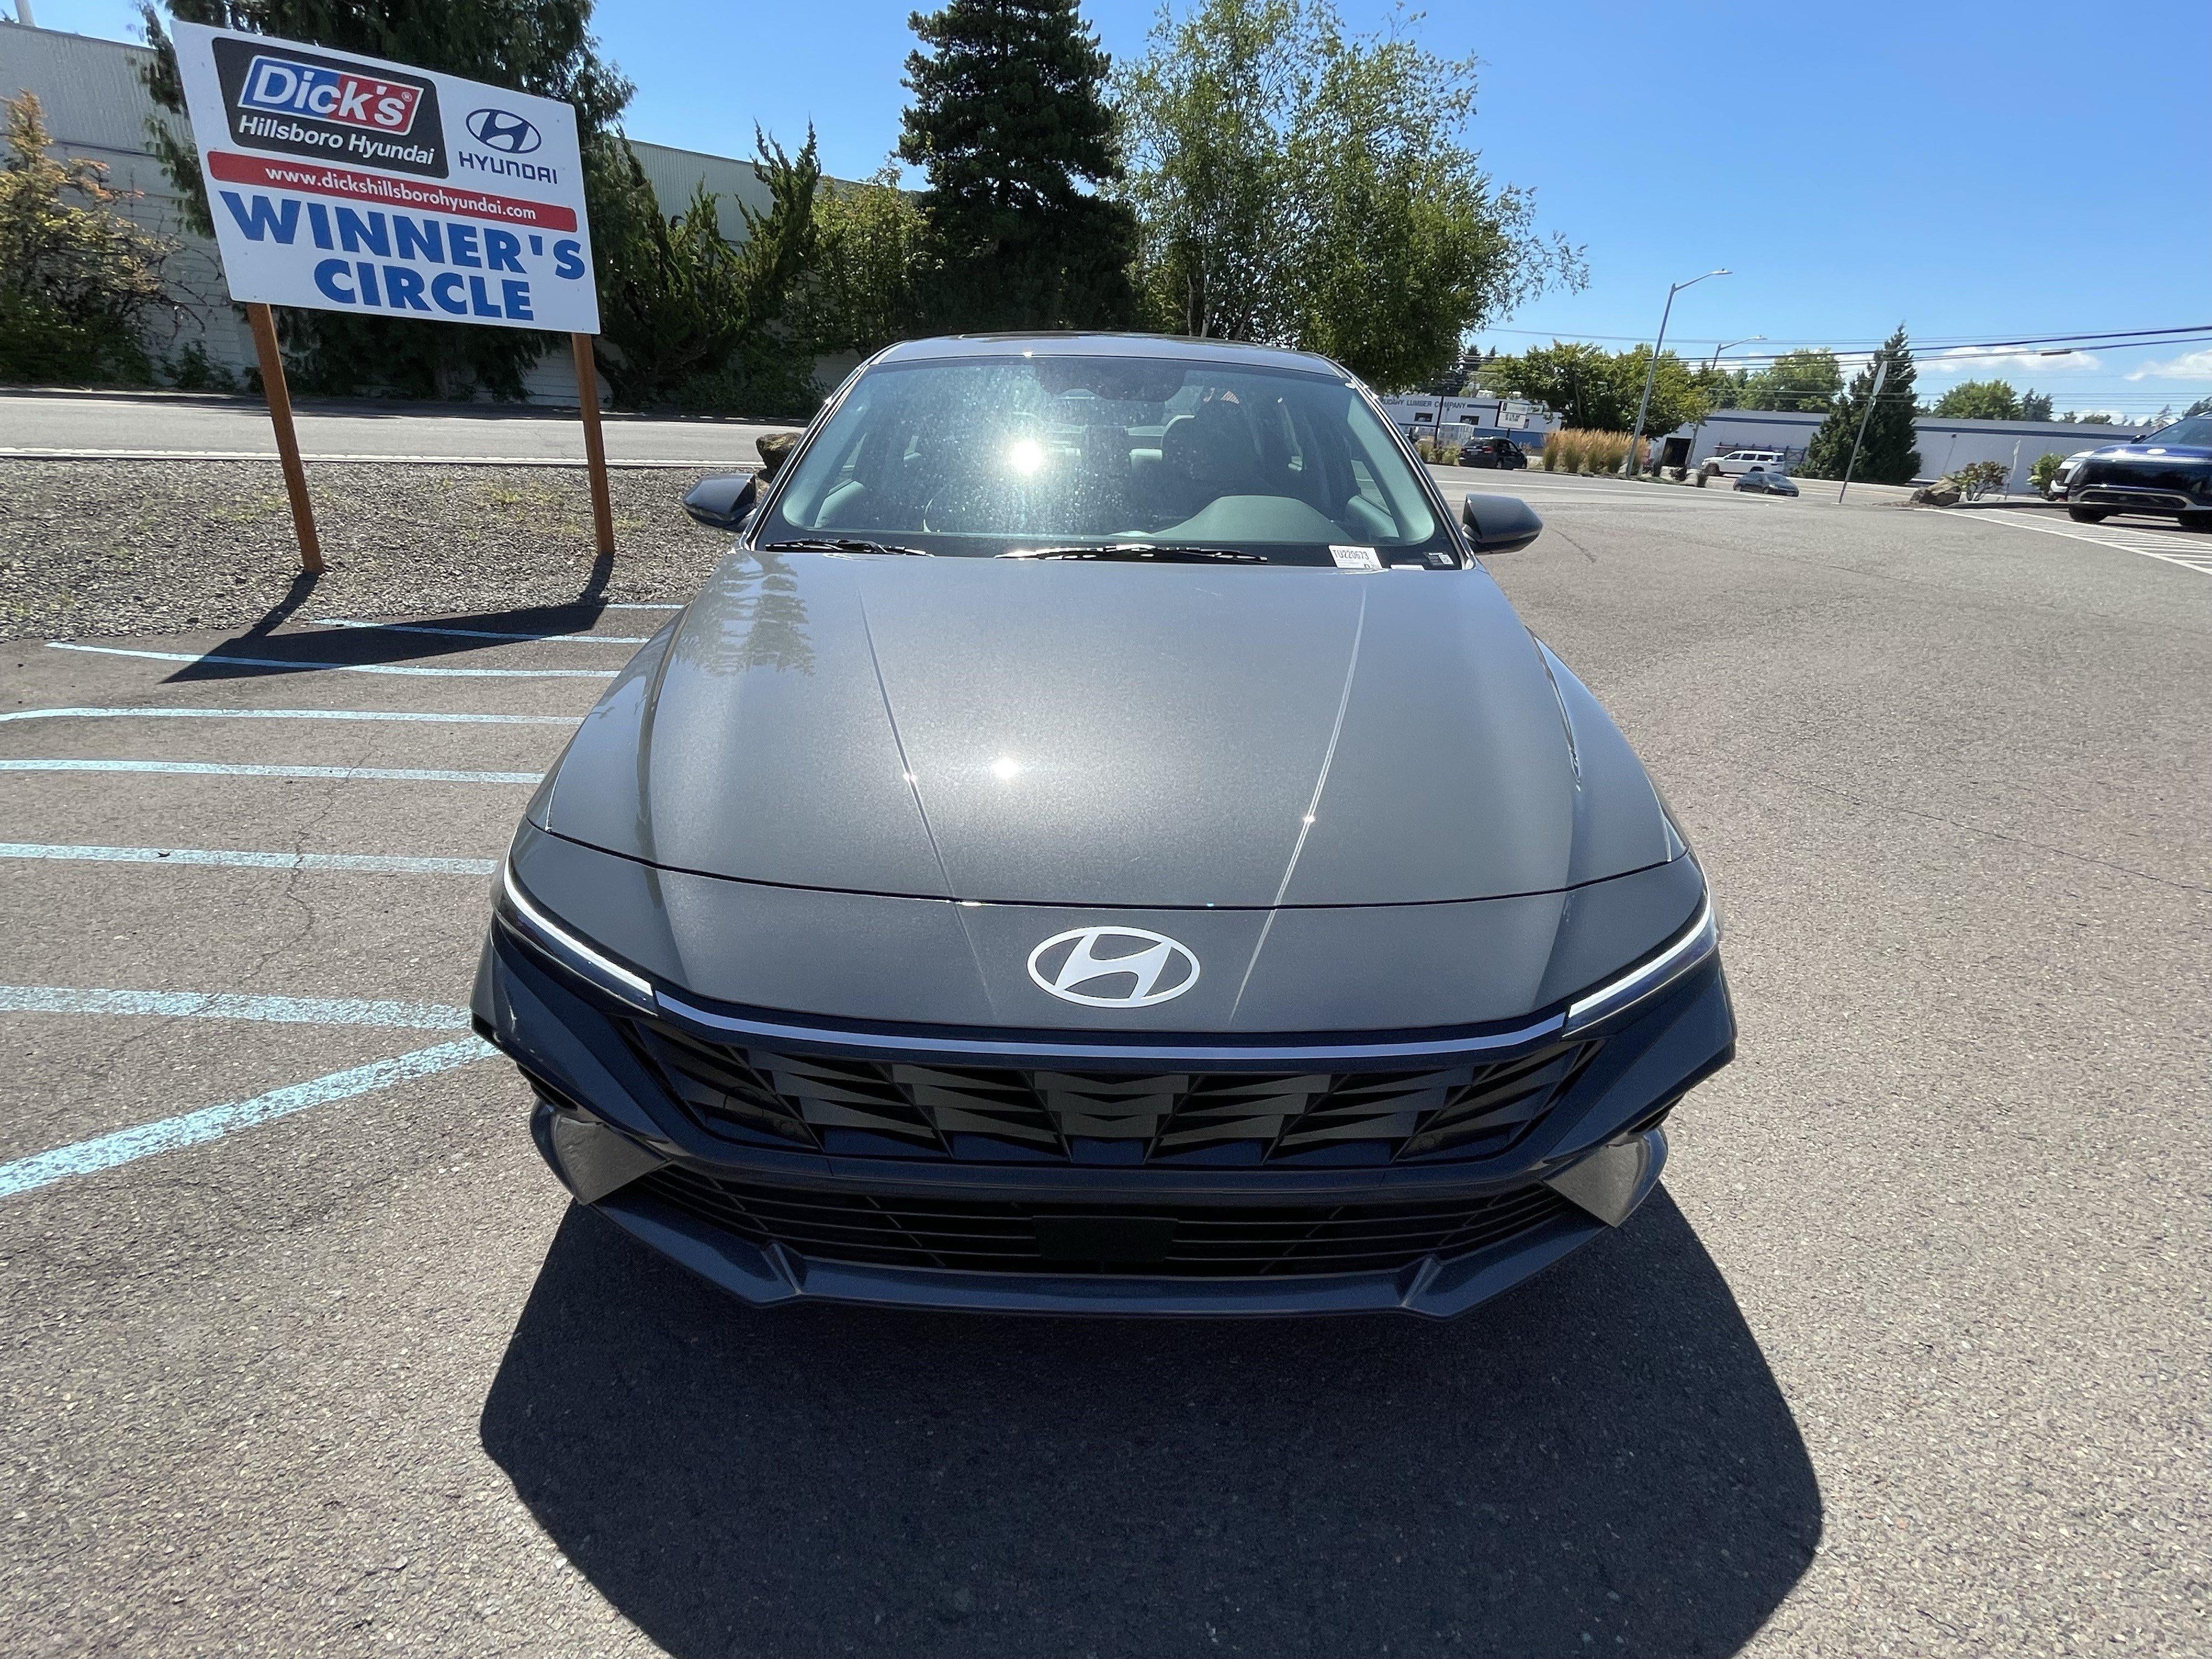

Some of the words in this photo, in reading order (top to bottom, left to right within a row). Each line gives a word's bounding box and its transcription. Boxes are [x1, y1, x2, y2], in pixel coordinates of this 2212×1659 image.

[238, 115, 344, 149] Hillsboro
[348, 133, 435, 165] Hyundai
[265, 167, 537, 219] www.dickshillsborohyundai.com
[458, 151, 558, 184] HYUNDAI
[219, 190, 585, 280] WINNER'S
[314, 258, 534, 320] CIRCLE
